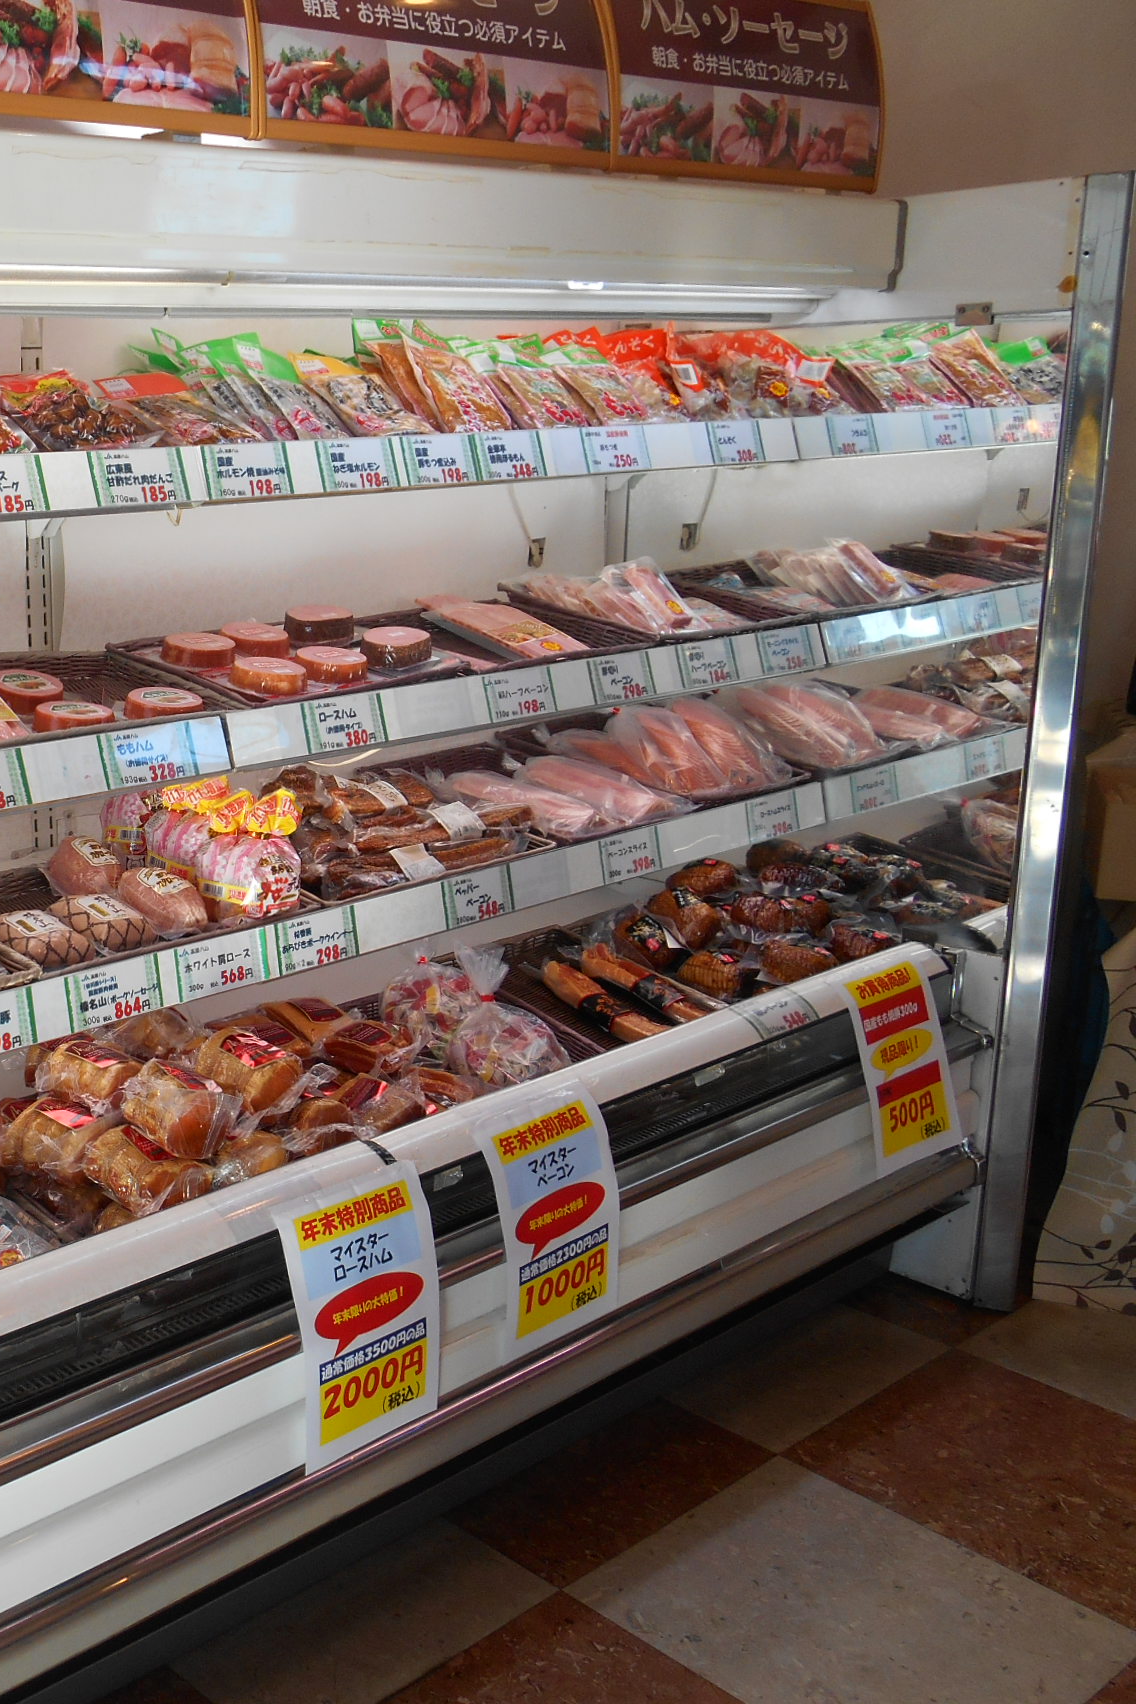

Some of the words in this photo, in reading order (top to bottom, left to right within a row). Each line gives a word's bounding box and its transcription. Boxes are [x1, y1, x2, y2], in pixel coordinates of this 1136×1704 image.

[302, 0, 567, 53] 朝食・お弁当に役立つ必須アイテム
[641, 0, 849, 59] ハム・ソーセージ
[651, 46, 849, 91] 朝食・お弁当に役立つ必須アイテム
[614, 454, 639, 468] 250円
[359, 472, 390, 489] 198円
[442, 467, 469, 483] 198円
[141, 486, 177, 503] 185円
[249, 479, 282, 497] 198円
[622, 683, 649, 700] 298円
[319, 708, 357, 723] ロースハム
[518, 699, 546, 715] 198円
[116, 742, 154, 755] ももハム
[345, 729, 377, 747] 380円
[148, 763, 186, 782] 328円
[607, 842, 648, 858] ベーコンスライス
[631, 856, 656, 874] 398円
[455, 883, 480, 896] ペッパー
[466, 893, 492, 907] ベーコン
[478, 900, 505, 921] 548円
[184, 948, 252, 974] ホワイト肩ロース
[316, 943, 348, 965] 298円
[220, 965, 254, 987] 568円
[114, 996, 151, 1020] 864円
[783, 1010, 811, 1029] 548円
[889, 1096, 935, 1134] 500円
[500, 1107, 587, 1156] 年末特別商品
[921, 1117, 946, 1139] （税込）
[528, 1144, 577, 1172] マイスター
[536, 1160, 577, 1186] ベーコン
[300, 1186, 407, 1244] 年末特別商品
[330, 1232, 390, 1261] マイスター
[519, 1224, 609, 1284] 通常価格2300円の品
[332, 1249, 394, 1283] ロースハム
[525, 1250, 606, 1315] 1000円
[331, 1286, 406, 1326] 年末限りの大特価！
[571, 1283, 604, 1311] （税込）
[320, 1320, 427, 1383] 通常価格3500円の品
[324, 1344, 424, 1421] 2000円
[383, 1383, 419, 1414] （税込）
